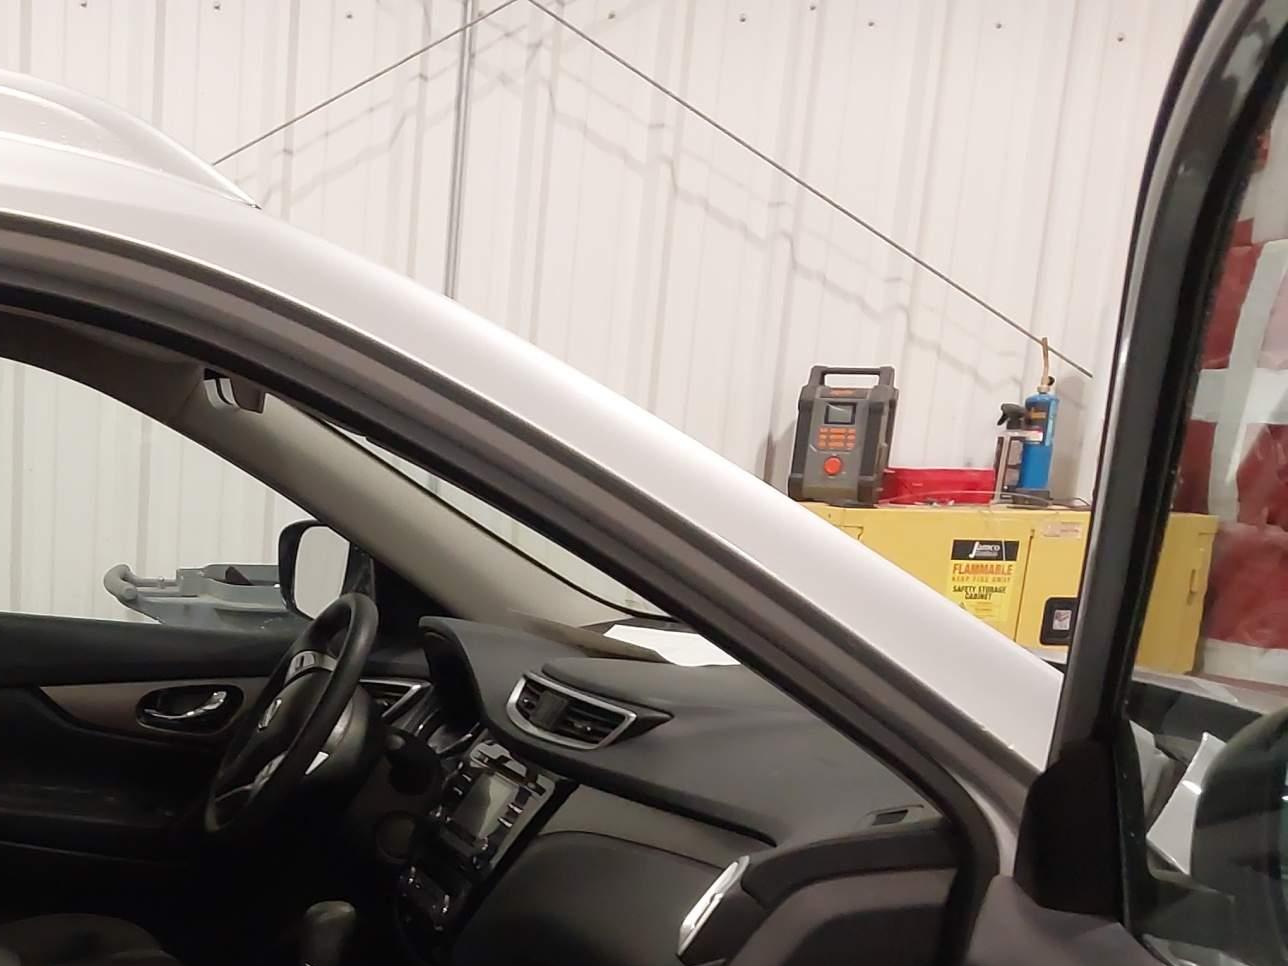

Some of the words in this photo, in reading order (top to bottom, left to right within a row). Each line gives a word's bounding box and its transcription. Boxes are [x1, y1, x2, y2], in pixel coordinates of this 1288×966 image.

[953, 564, 1013, 575] FLAMMABLE
[953, 585, 976, 593] SAFETY
[978, 585, 1006, 593] STORAGE
